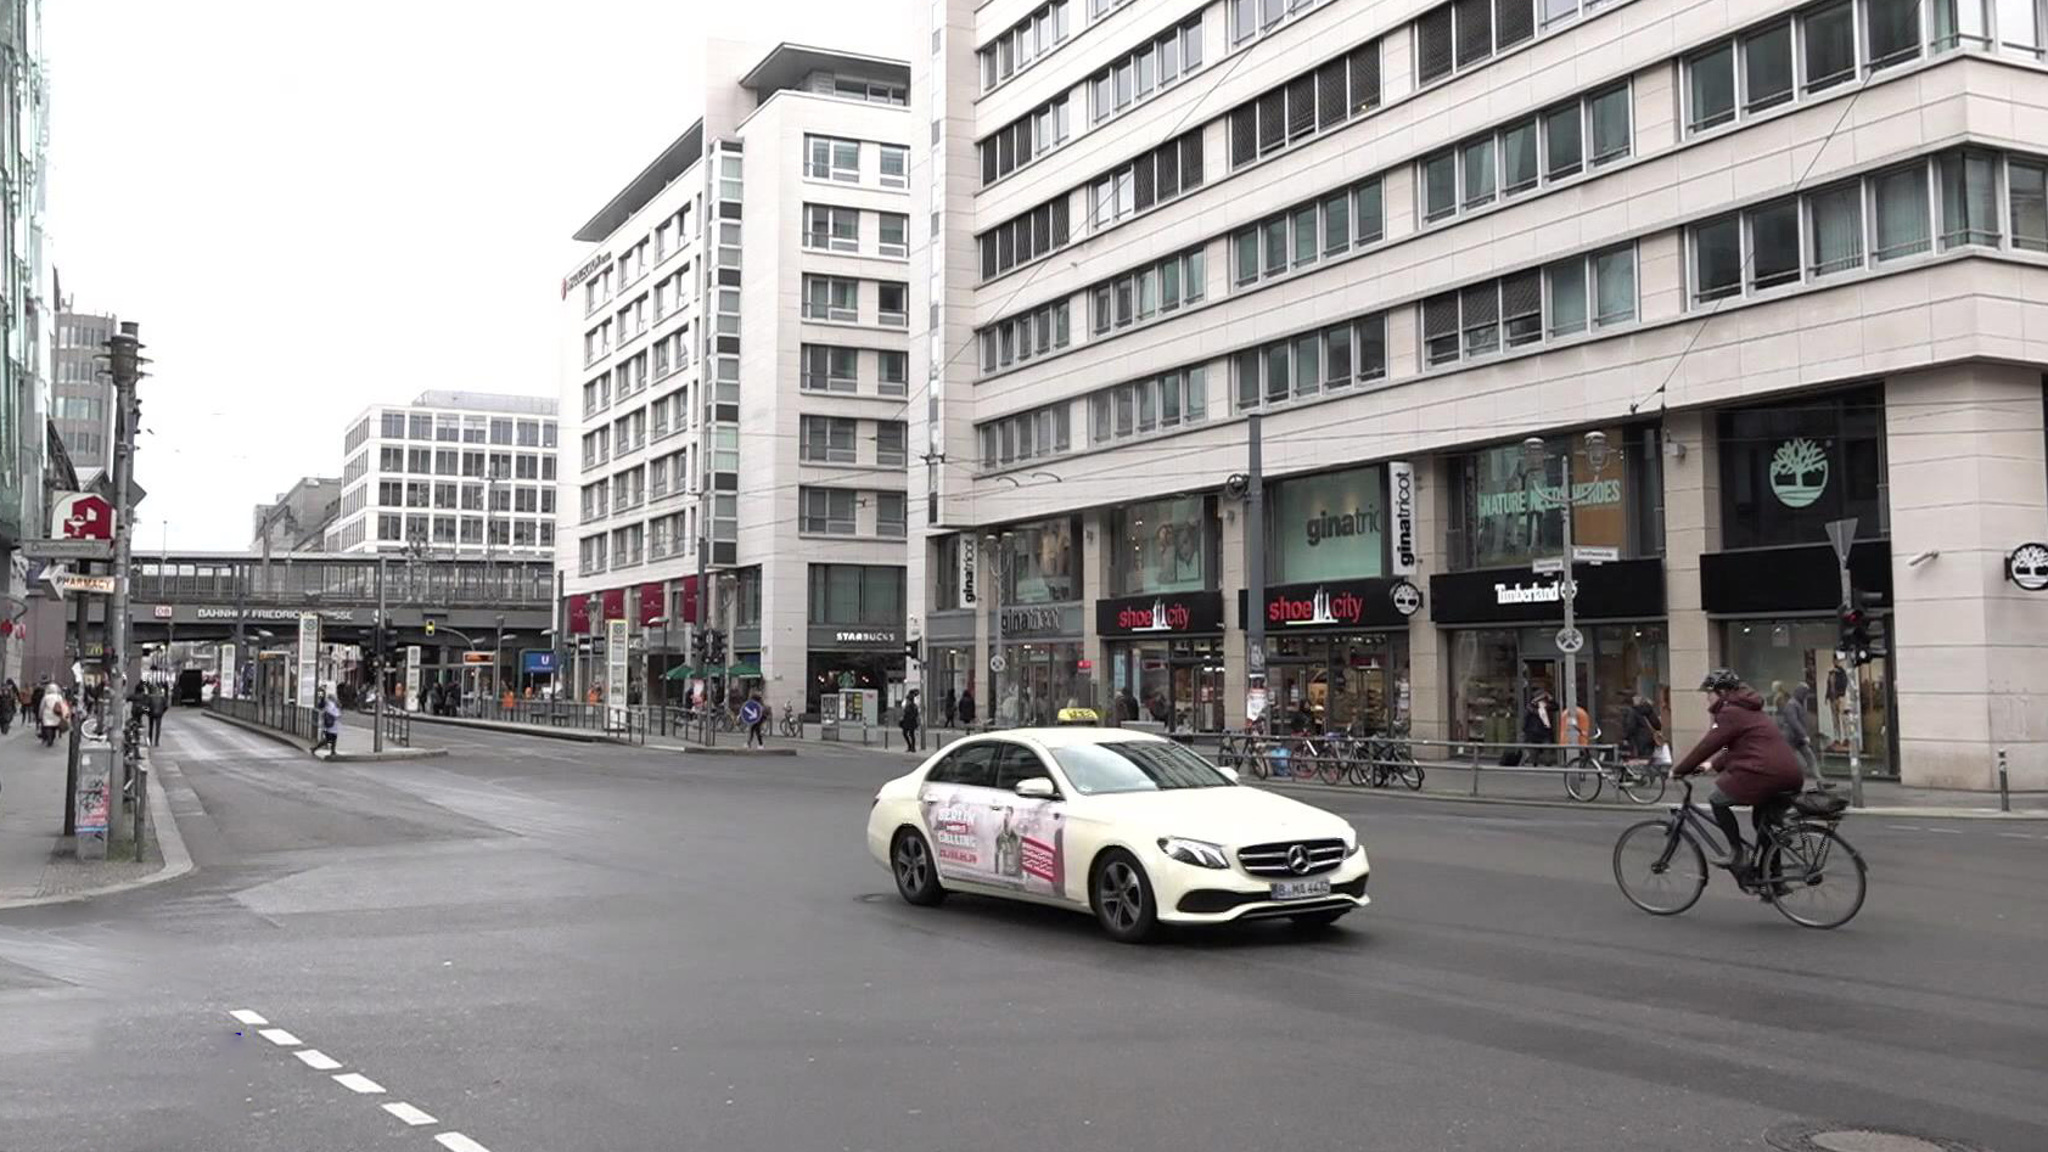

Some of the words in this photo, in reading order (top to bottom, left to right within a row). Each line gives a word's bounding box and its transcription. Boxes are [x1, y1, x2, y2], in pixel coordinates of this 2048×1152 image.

[1396, 472, 1416, 567] ginatricot
[56, 576, 112, 590] PHARMACY
[1495, 581, 1559, 604] Timberland
[197, 607, 250, 620] BAHNHF
[1269, 596, 1312, 621] shoe
[1331, 591, 1364, 623] city
[1119, 605, 1152, 629] shoe
[1167, 603, 1190, 630] city
[836, 631, 895, 642] STARBUCKS
[541, 655, 550, 665] U
